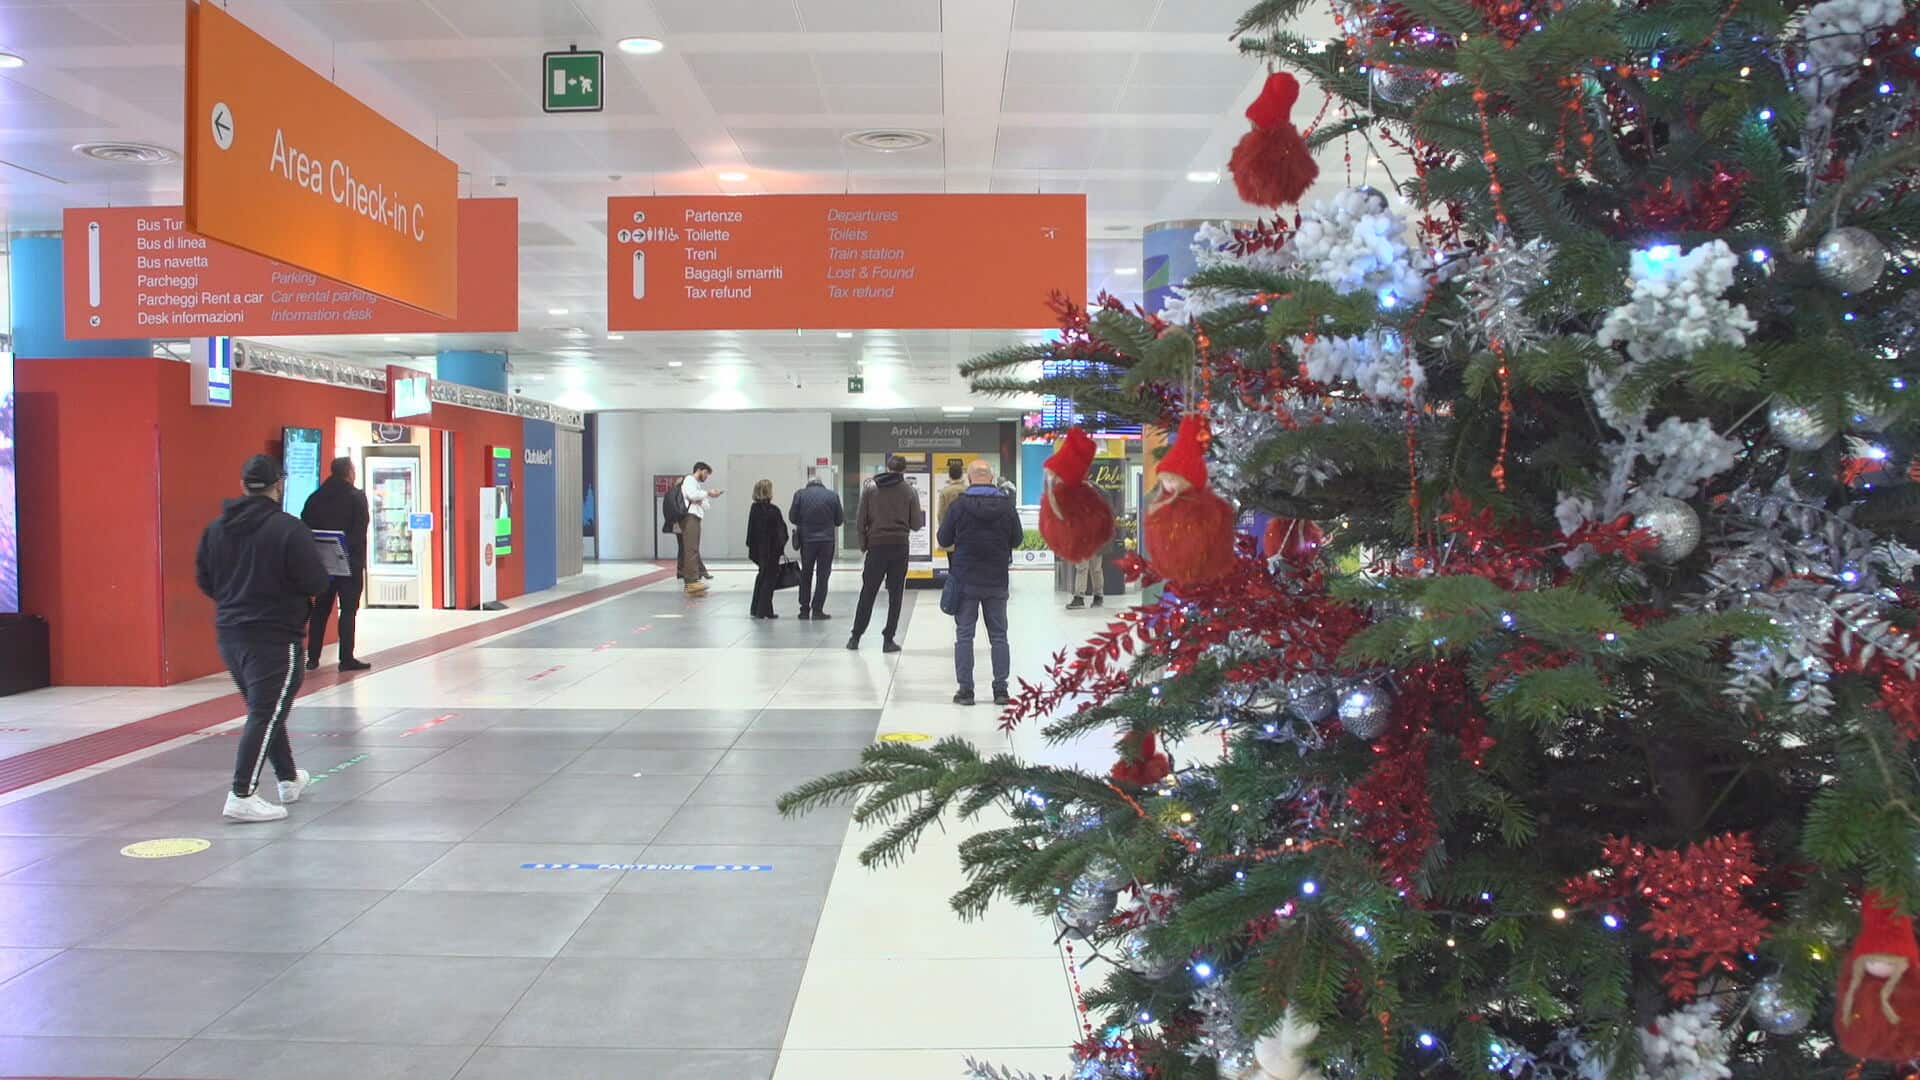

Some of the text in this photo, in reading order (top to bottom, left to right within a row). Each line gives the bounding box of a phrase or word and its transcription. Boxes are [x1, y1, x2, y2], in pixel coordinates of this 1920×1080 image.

[270, 128, 425, 242] Area Check-in C
[685, 210, 743, 222] Partenze
[827, 209, 898, 223] Departures
[137, 219, 184, 231] Bus Tur
[685, 229, 730, 241] Toilette
[828, 229, 868, 241] Toilets
[137, 238, 206, 250] Bus di linea
[685, 248, 717, 260] Treni
[828, 248, 904, 260] Train station
[137, 257, 208, 268] Bus navetta
[271, 272, 317, 286] Parking
[685, 266, 783, 281] Bagagli smarriti
[827, 267, 914, 279] Lost & Found
[137, 275, 198, 288] Parcheggi
[271, 289, 378, 304] Car rental parking
[685, 286, 752, 298] Tax refund
[828, 286, 894, 298] Tax refund
[137, 292, 264, 307] Parcheggi Rent a car
[138, 310, 244, 324] Desk informazioni
[271, 309, 372, 321] Information desk
[891, 426, 922, 436] Arrivi
[933, 426, 970, 436] Arrivals
